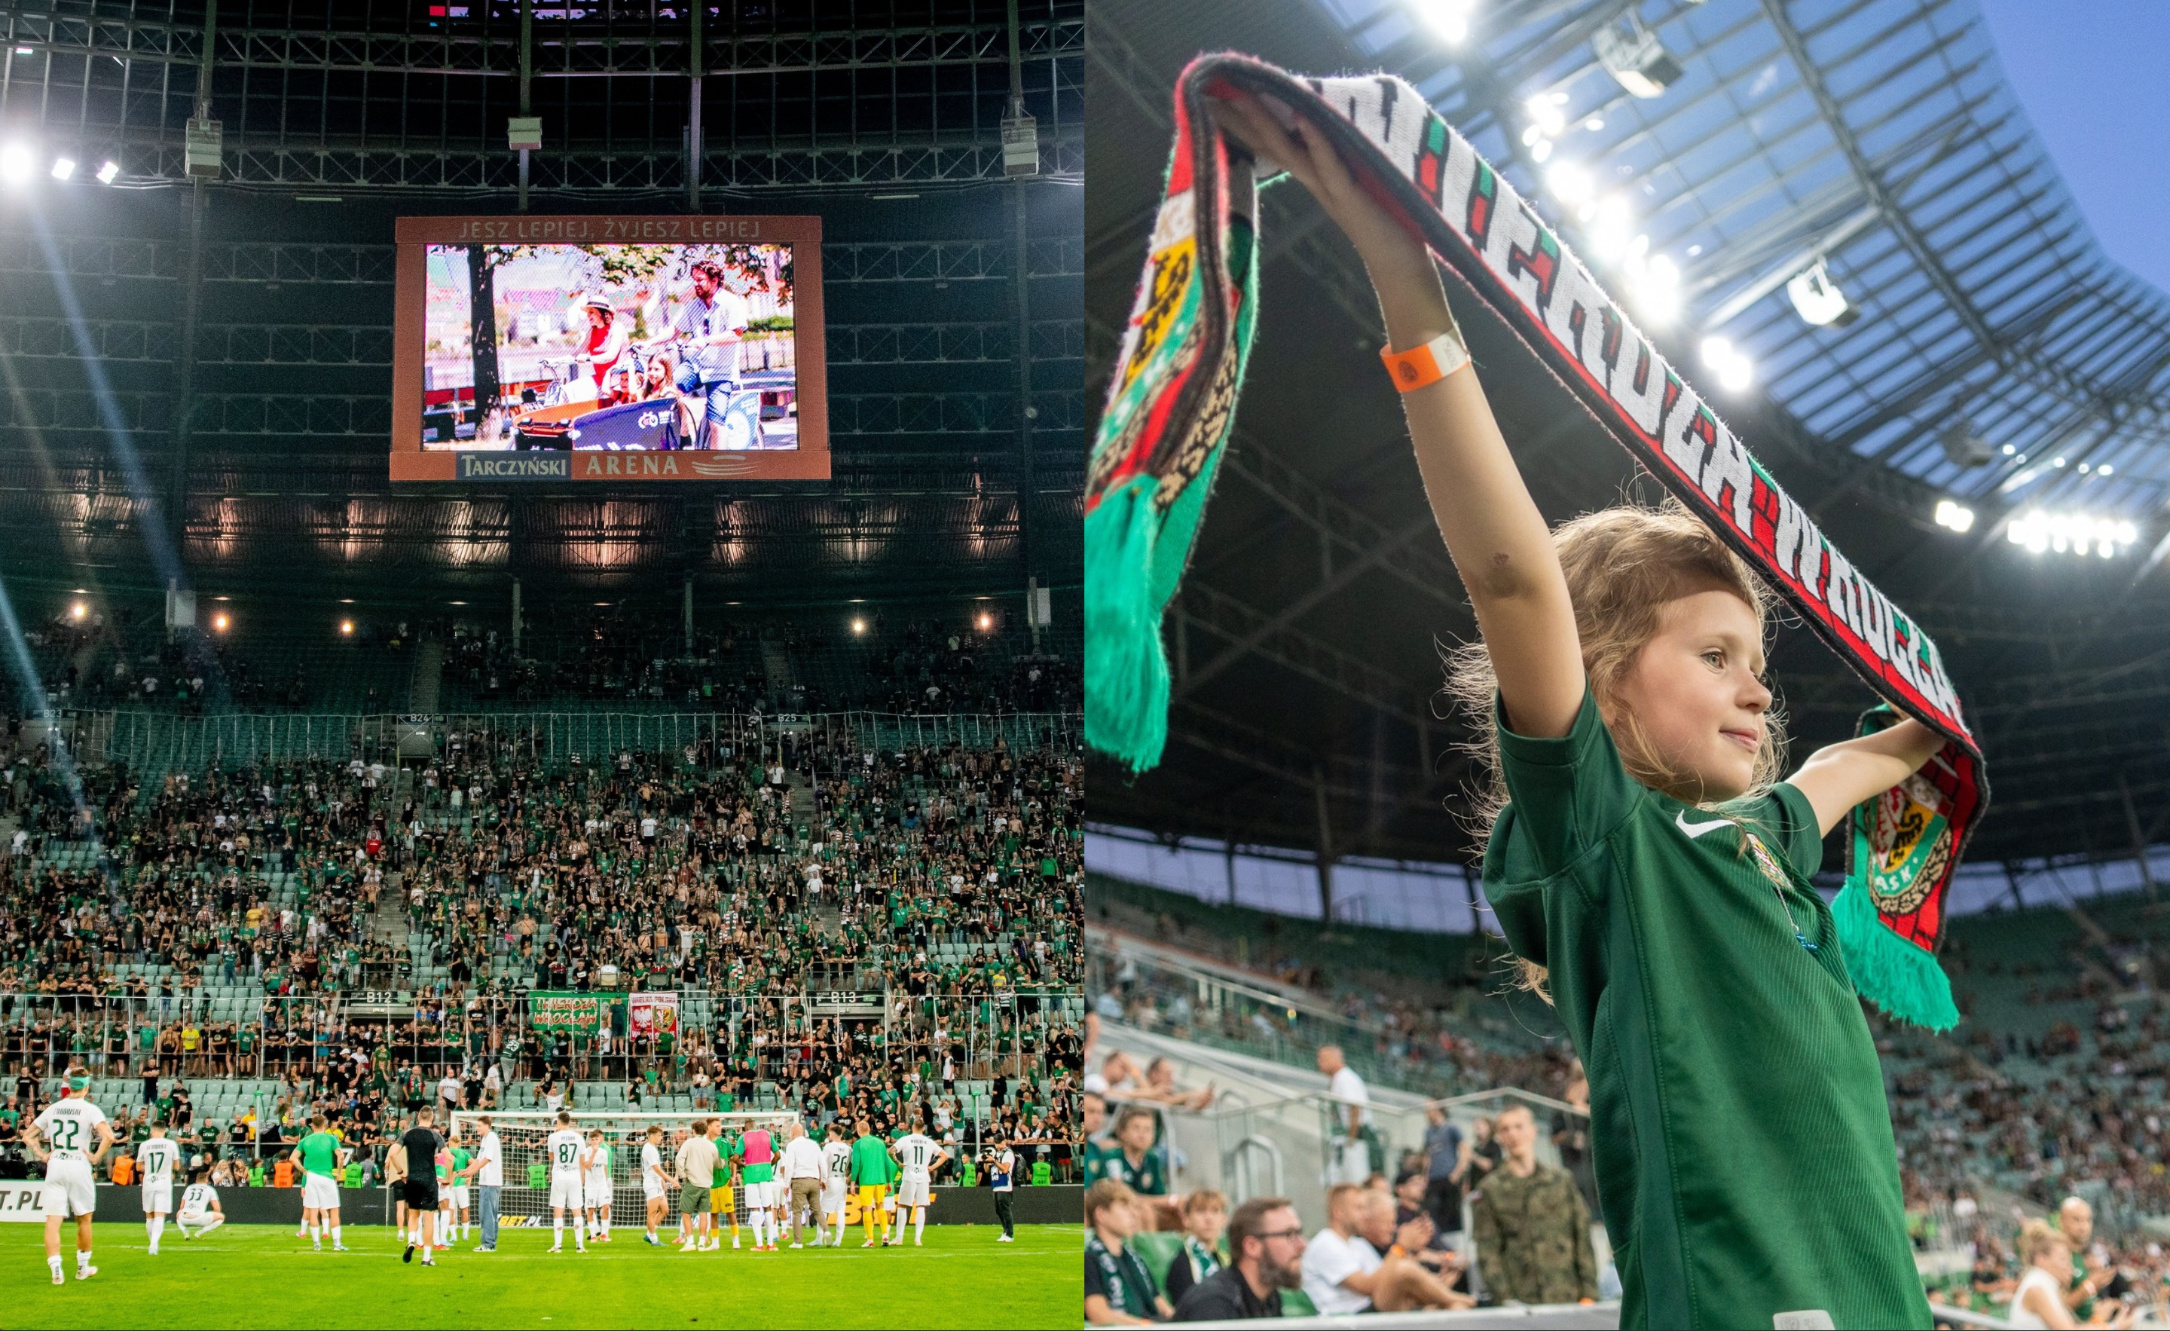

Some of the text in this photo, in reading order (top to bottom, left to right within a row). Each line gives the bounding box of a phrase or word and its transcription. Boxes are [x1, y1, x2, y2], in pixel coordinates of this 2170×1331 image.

[459, 217, 761, 240] JESZ LEPIEJ, ŻYJESZ LEPIEJ
[585, 455, 680, 476] ARENA
[366, 991, 392, 1003] B12
[831, 991, 856, 1003] B13
[52, 1119, 79, 1150] 22
[149, 1152, 165, 1173] 17
[558, 1143, 578, 1163] 87
[832, 1153, 848, 1173] 26
[914, 1145, 924, 1165] 11
[496, 1213, 542, 1227] BET.PL
